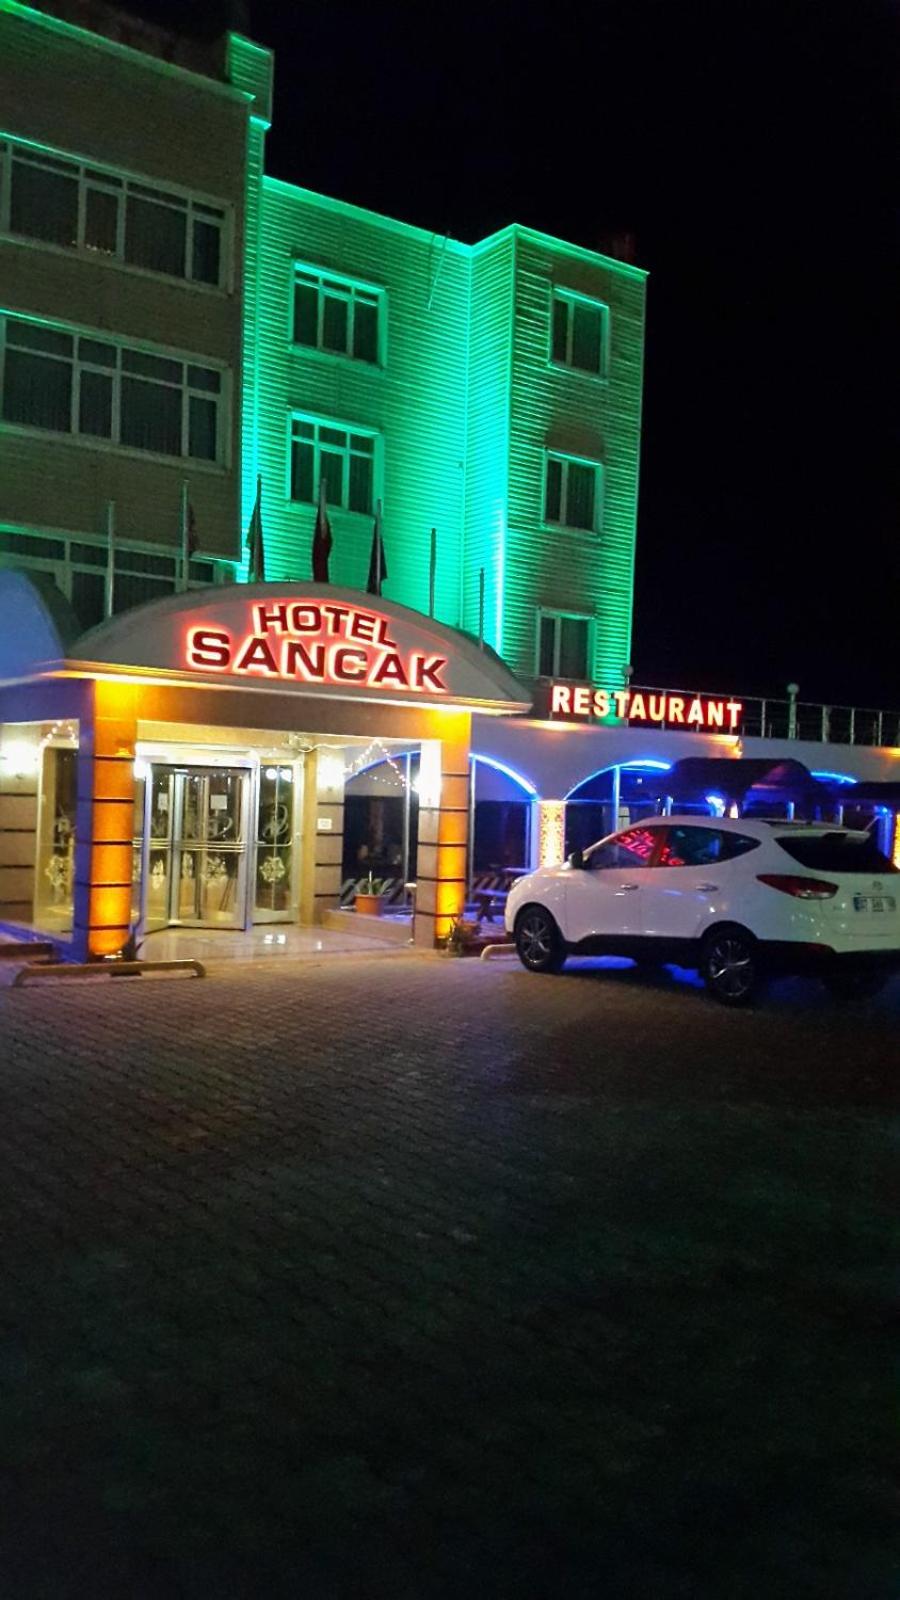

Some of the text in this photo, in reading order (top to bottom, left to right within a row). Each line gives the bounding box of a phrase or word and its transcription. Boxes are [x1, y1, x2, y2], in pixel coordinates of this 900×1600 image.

[254, 603, 398, 650] HOTEL
[187, 628, 447, 691] SANCAK
[551, 685, 742, 728] RESTAURANT
